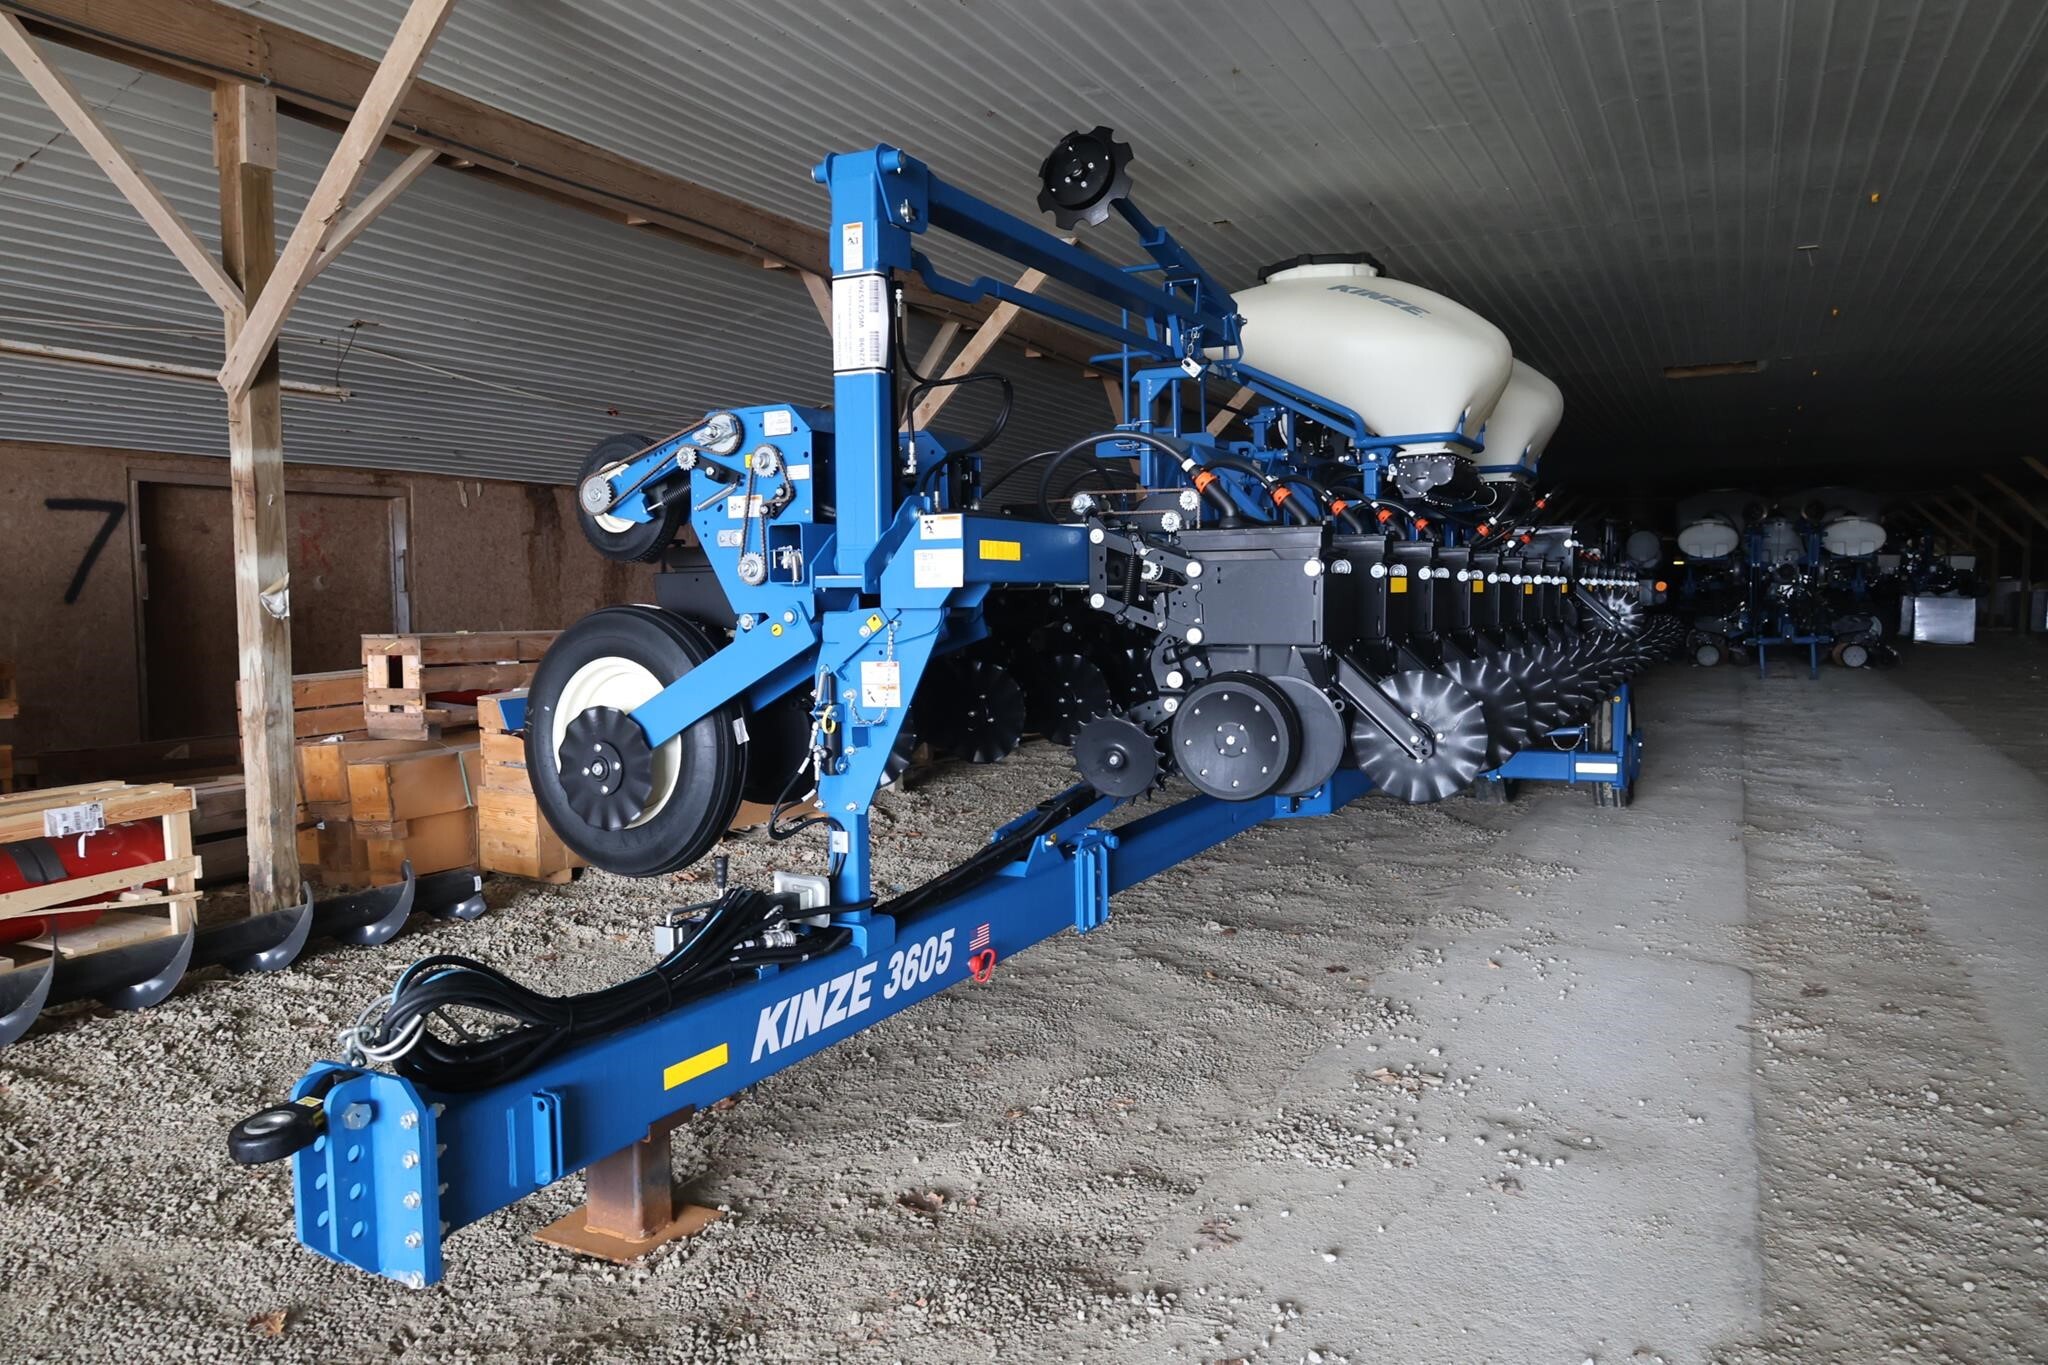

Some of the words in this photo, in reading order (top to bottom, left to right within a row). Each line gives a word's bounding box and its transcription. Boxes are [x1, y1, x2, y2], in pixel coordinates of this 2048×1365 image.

[1327, 285, 1431, 317] KINZE
[44, 498, 127, 605] 7
[750, 961, 878, 1063] KINZE
[883, 928, 955, 999] 3605
